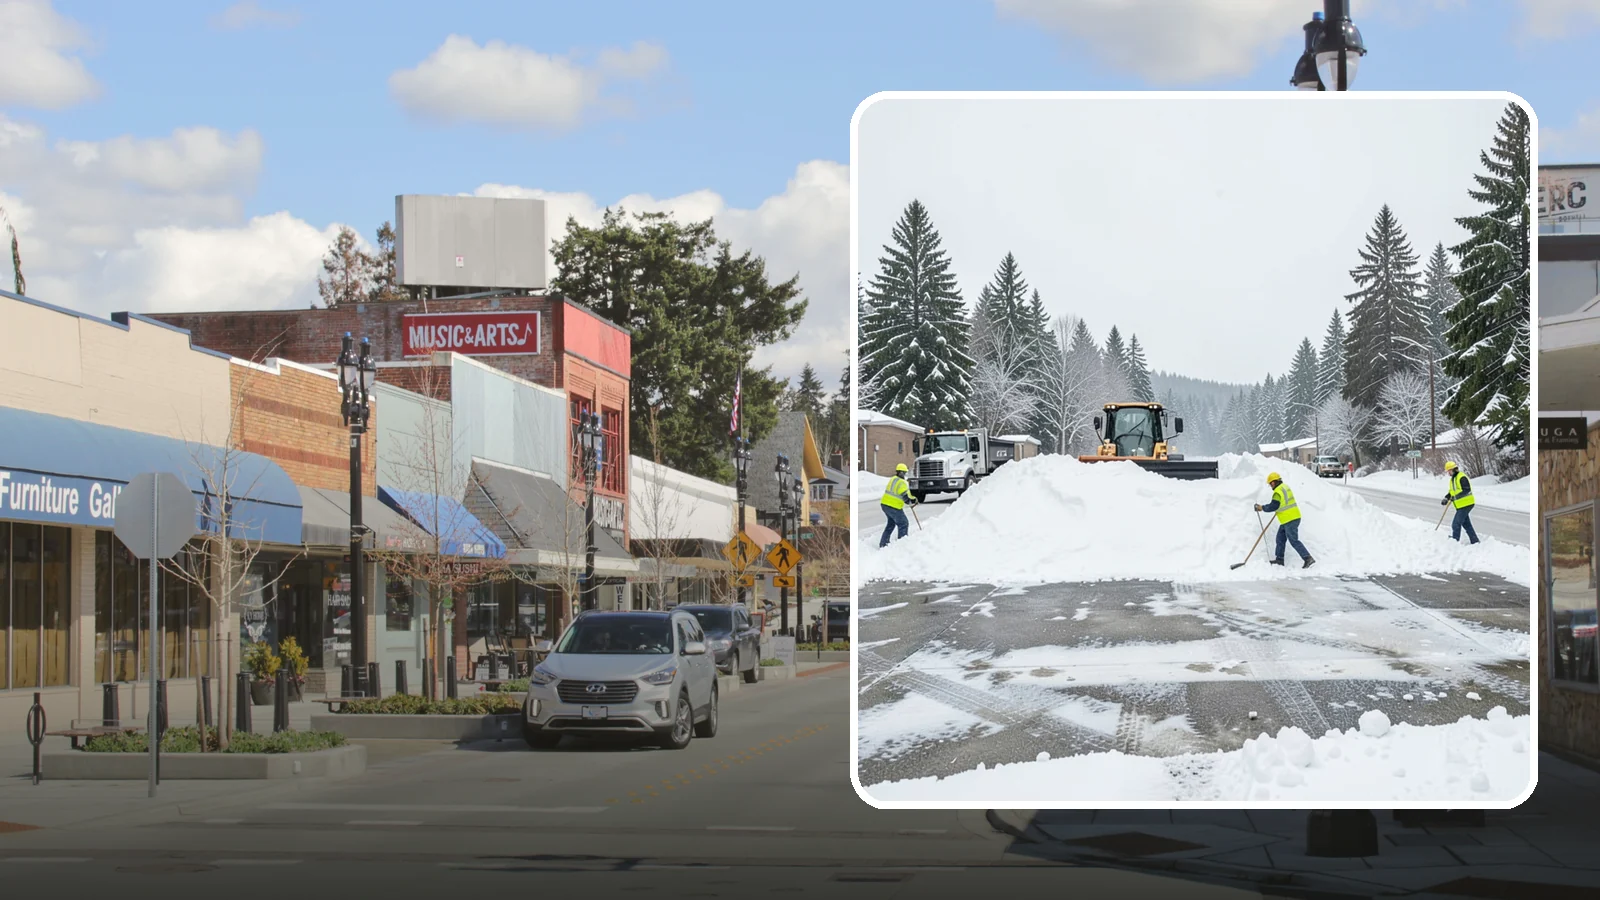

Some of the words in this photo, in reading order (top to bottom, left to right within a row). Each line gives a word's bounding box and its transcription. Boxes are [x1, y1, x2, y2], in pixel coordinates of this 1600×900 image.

[0, 472, 79, 515] Furniture
[90, 482, 122, 519] Gal
[453, 563, 480, 574] SUSHI
